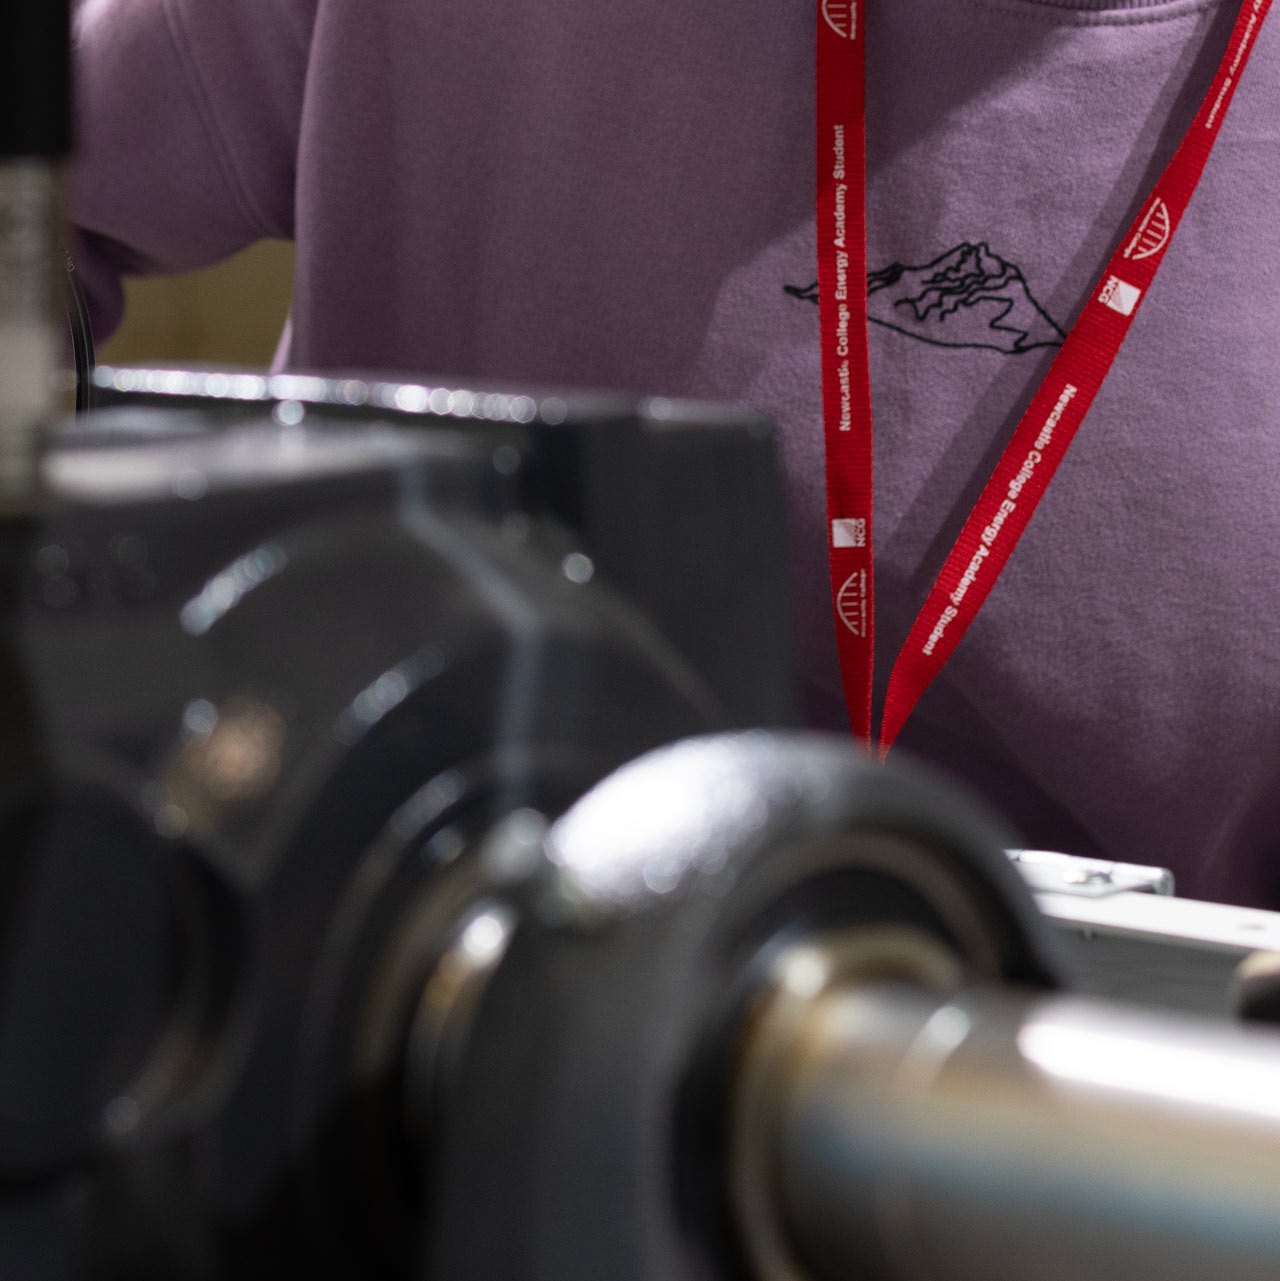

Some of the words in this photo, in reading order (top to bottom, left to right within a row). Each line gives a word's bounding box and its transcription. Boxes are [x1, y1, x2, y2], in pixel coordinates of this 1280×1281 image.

[832, 124, 845, 180] Student
[833, 183, 848, 248] Academy
[835, 250, 849, 301] Energy
[1097, 274, 1120, 305] NCG
[1033, 383, 1079, 451] Newcastle
[1007, 450, 1043, 500] College
[857, 518, 867, 548] NCG
[980, 499, 1017, 547] Energy
[949, 544, 991, 606] Academy
[922, 604, 959, 657] Student
